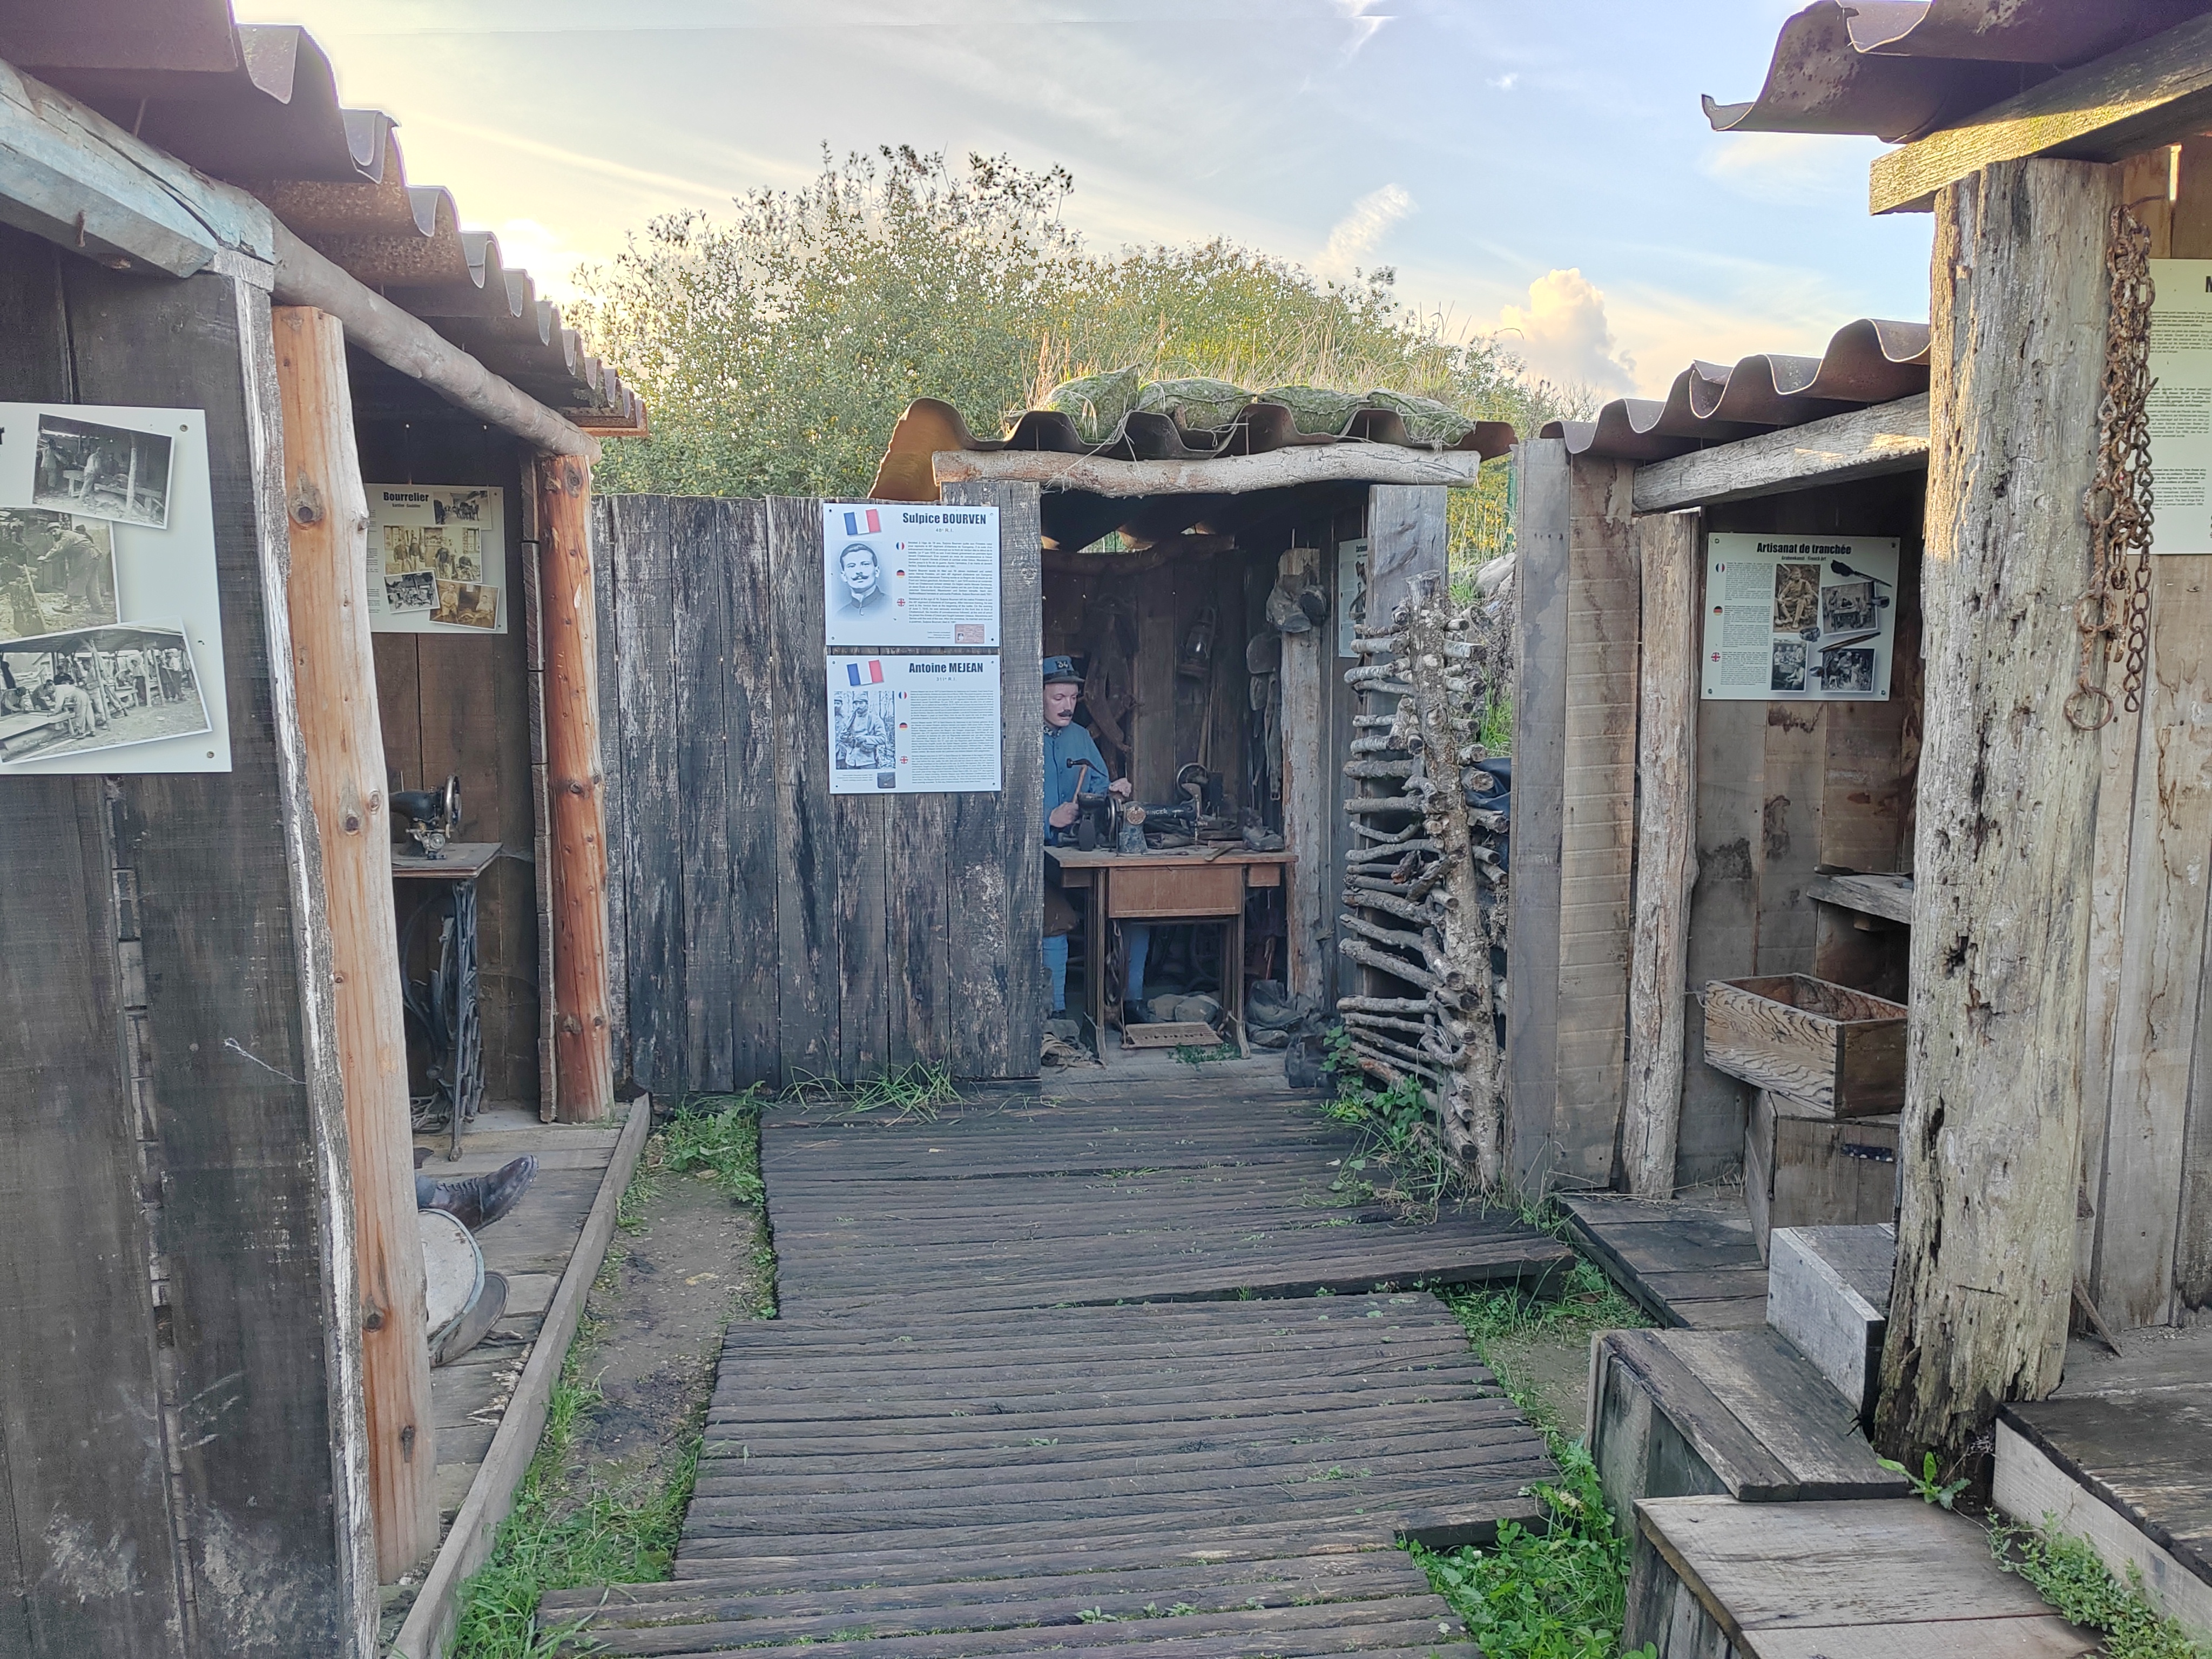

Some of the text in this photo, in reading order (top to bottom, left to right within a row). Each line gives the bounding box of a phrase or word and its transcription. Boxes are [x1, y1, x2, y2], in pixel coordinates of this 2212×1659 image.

[383, 491, 429, 502] Bourrelier
[902, 512, 986, 524] Sulpice BOURVEN
[1757, 542, 1852, 555] Artisanat de tranchée
[909, 663, 983, 673] Antoine MEJEAN
